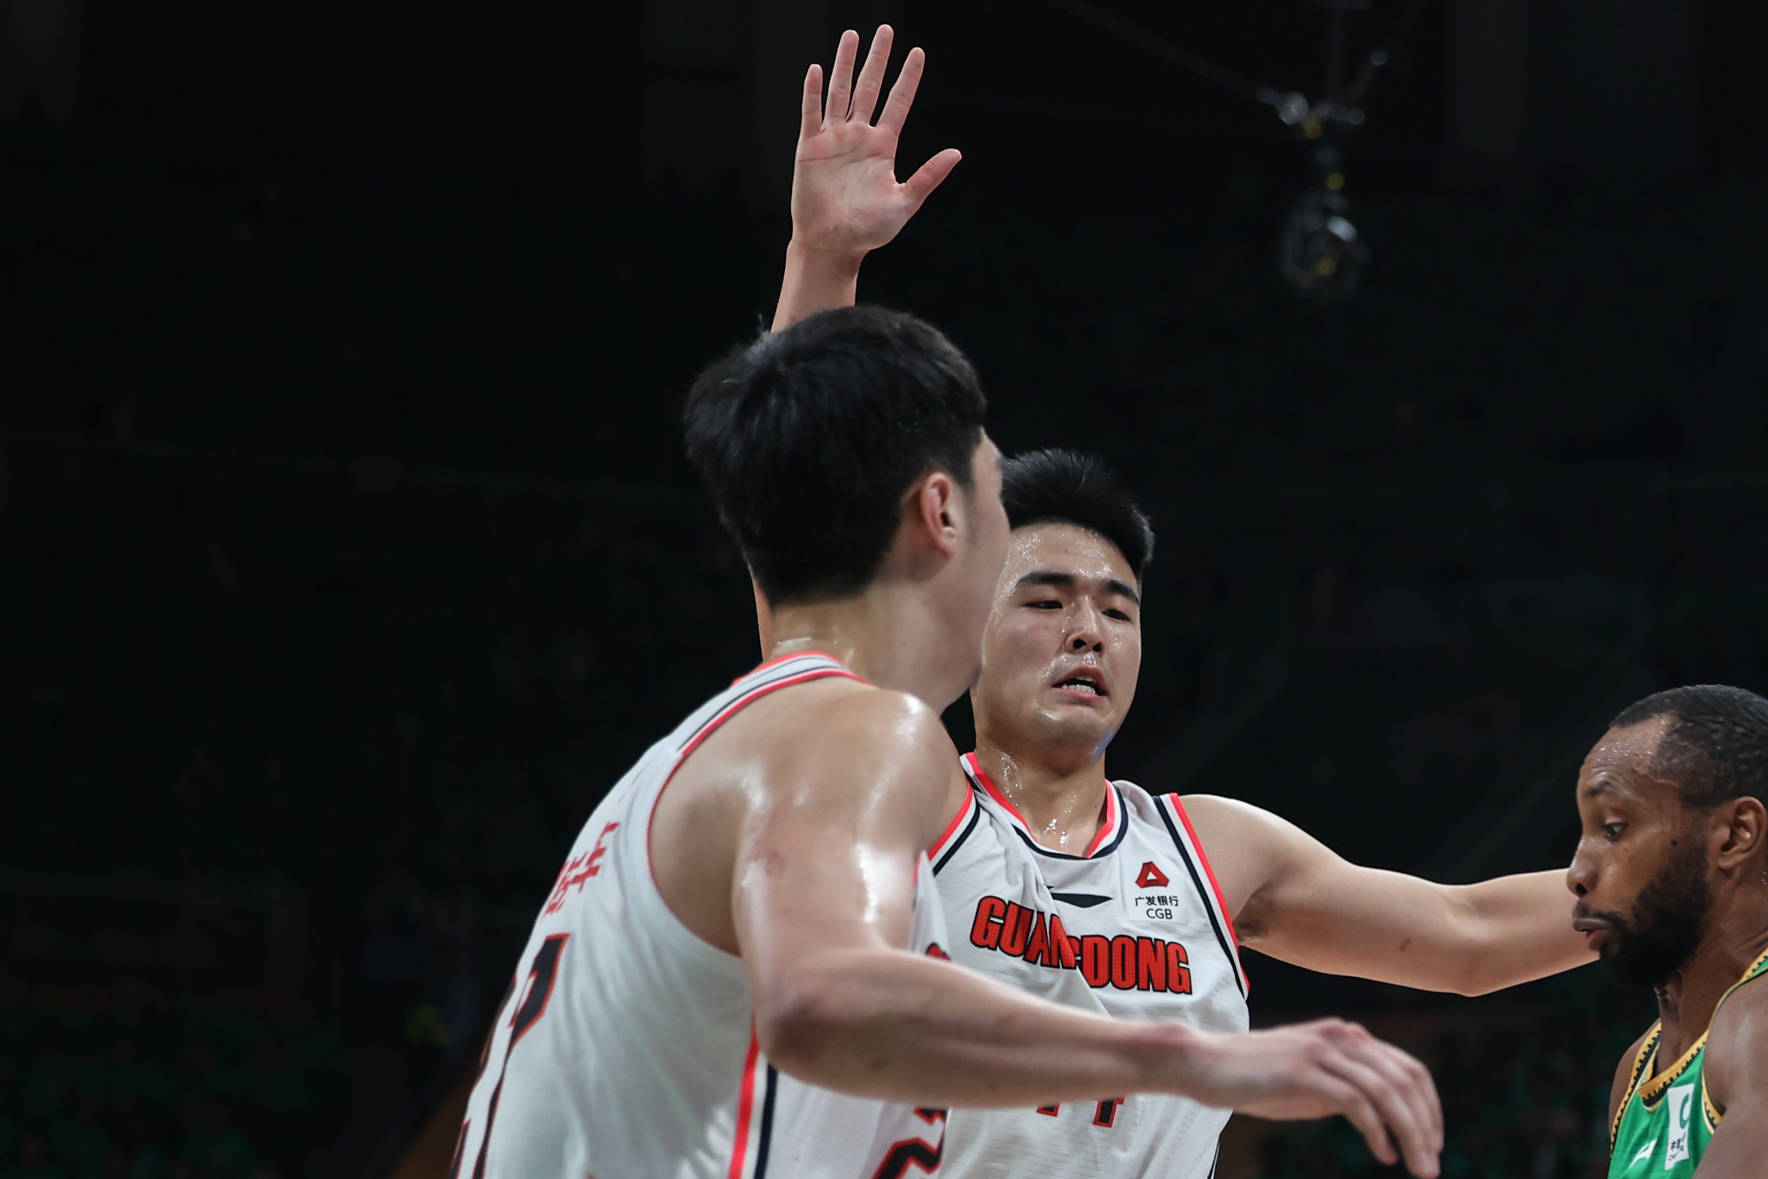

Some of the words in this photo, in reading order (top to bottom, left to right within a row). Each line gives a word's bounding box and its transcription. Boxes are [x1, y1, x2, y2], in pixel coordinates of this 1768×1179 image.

[1135, 895, 1179, 907] 广发银行
[1146, 908, 1173, 920] CGB
